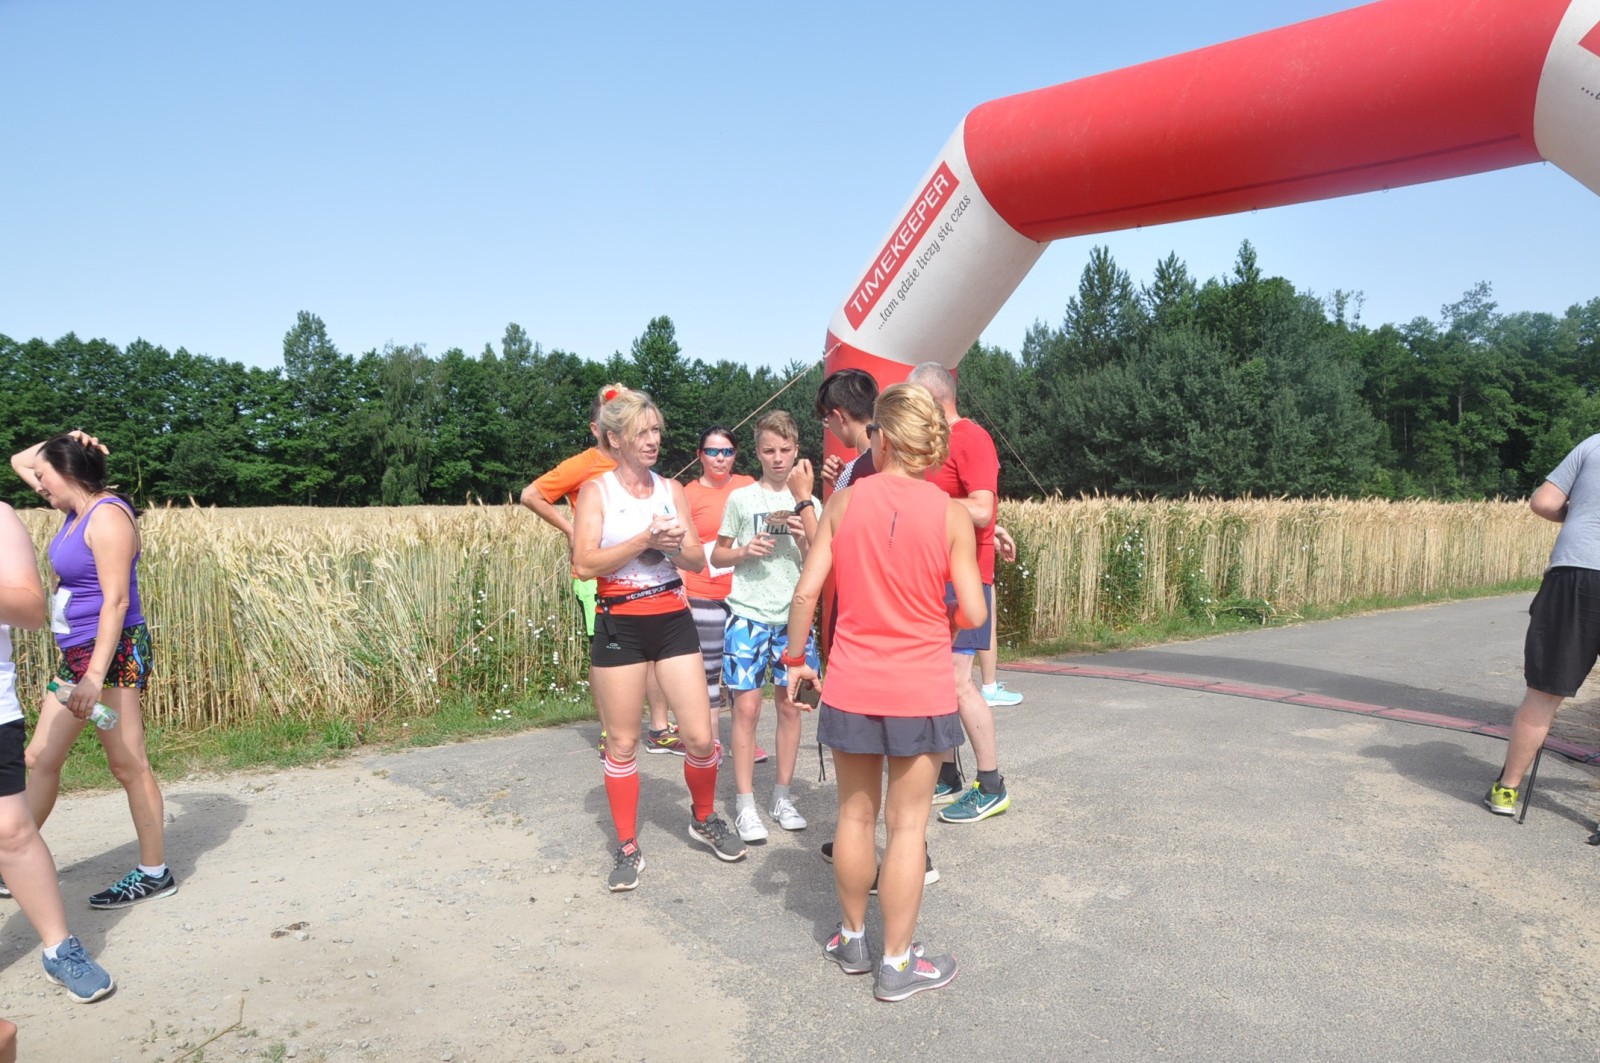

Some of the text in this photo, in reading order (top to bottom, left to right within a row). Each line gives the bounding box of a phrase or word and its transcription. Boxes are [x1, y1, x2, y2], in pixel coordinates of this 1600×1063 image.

[850, 173, 949, 313] TIMEKEEPER
[878, 195, 971, 330] ...tam gdzie liczy się czas
